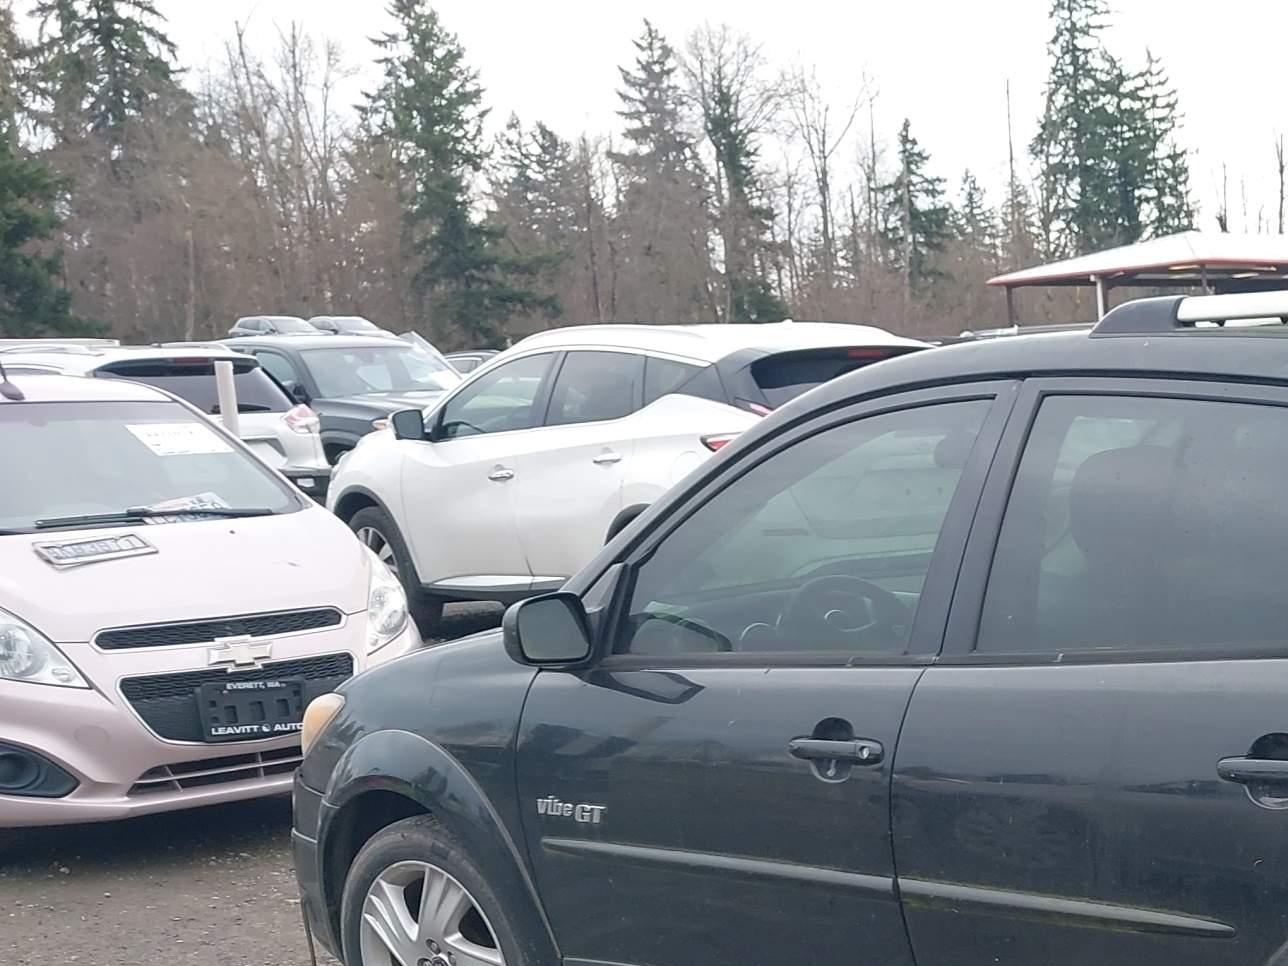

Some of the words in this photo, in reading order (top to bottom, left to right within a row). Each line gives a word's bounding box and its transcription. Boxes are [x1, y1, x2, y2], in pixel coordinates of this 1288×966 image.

[211, 725, 259, 735] LEAVITT
[536, 795, 573, 816] vibe
[575, 804, 606, 823] GT
